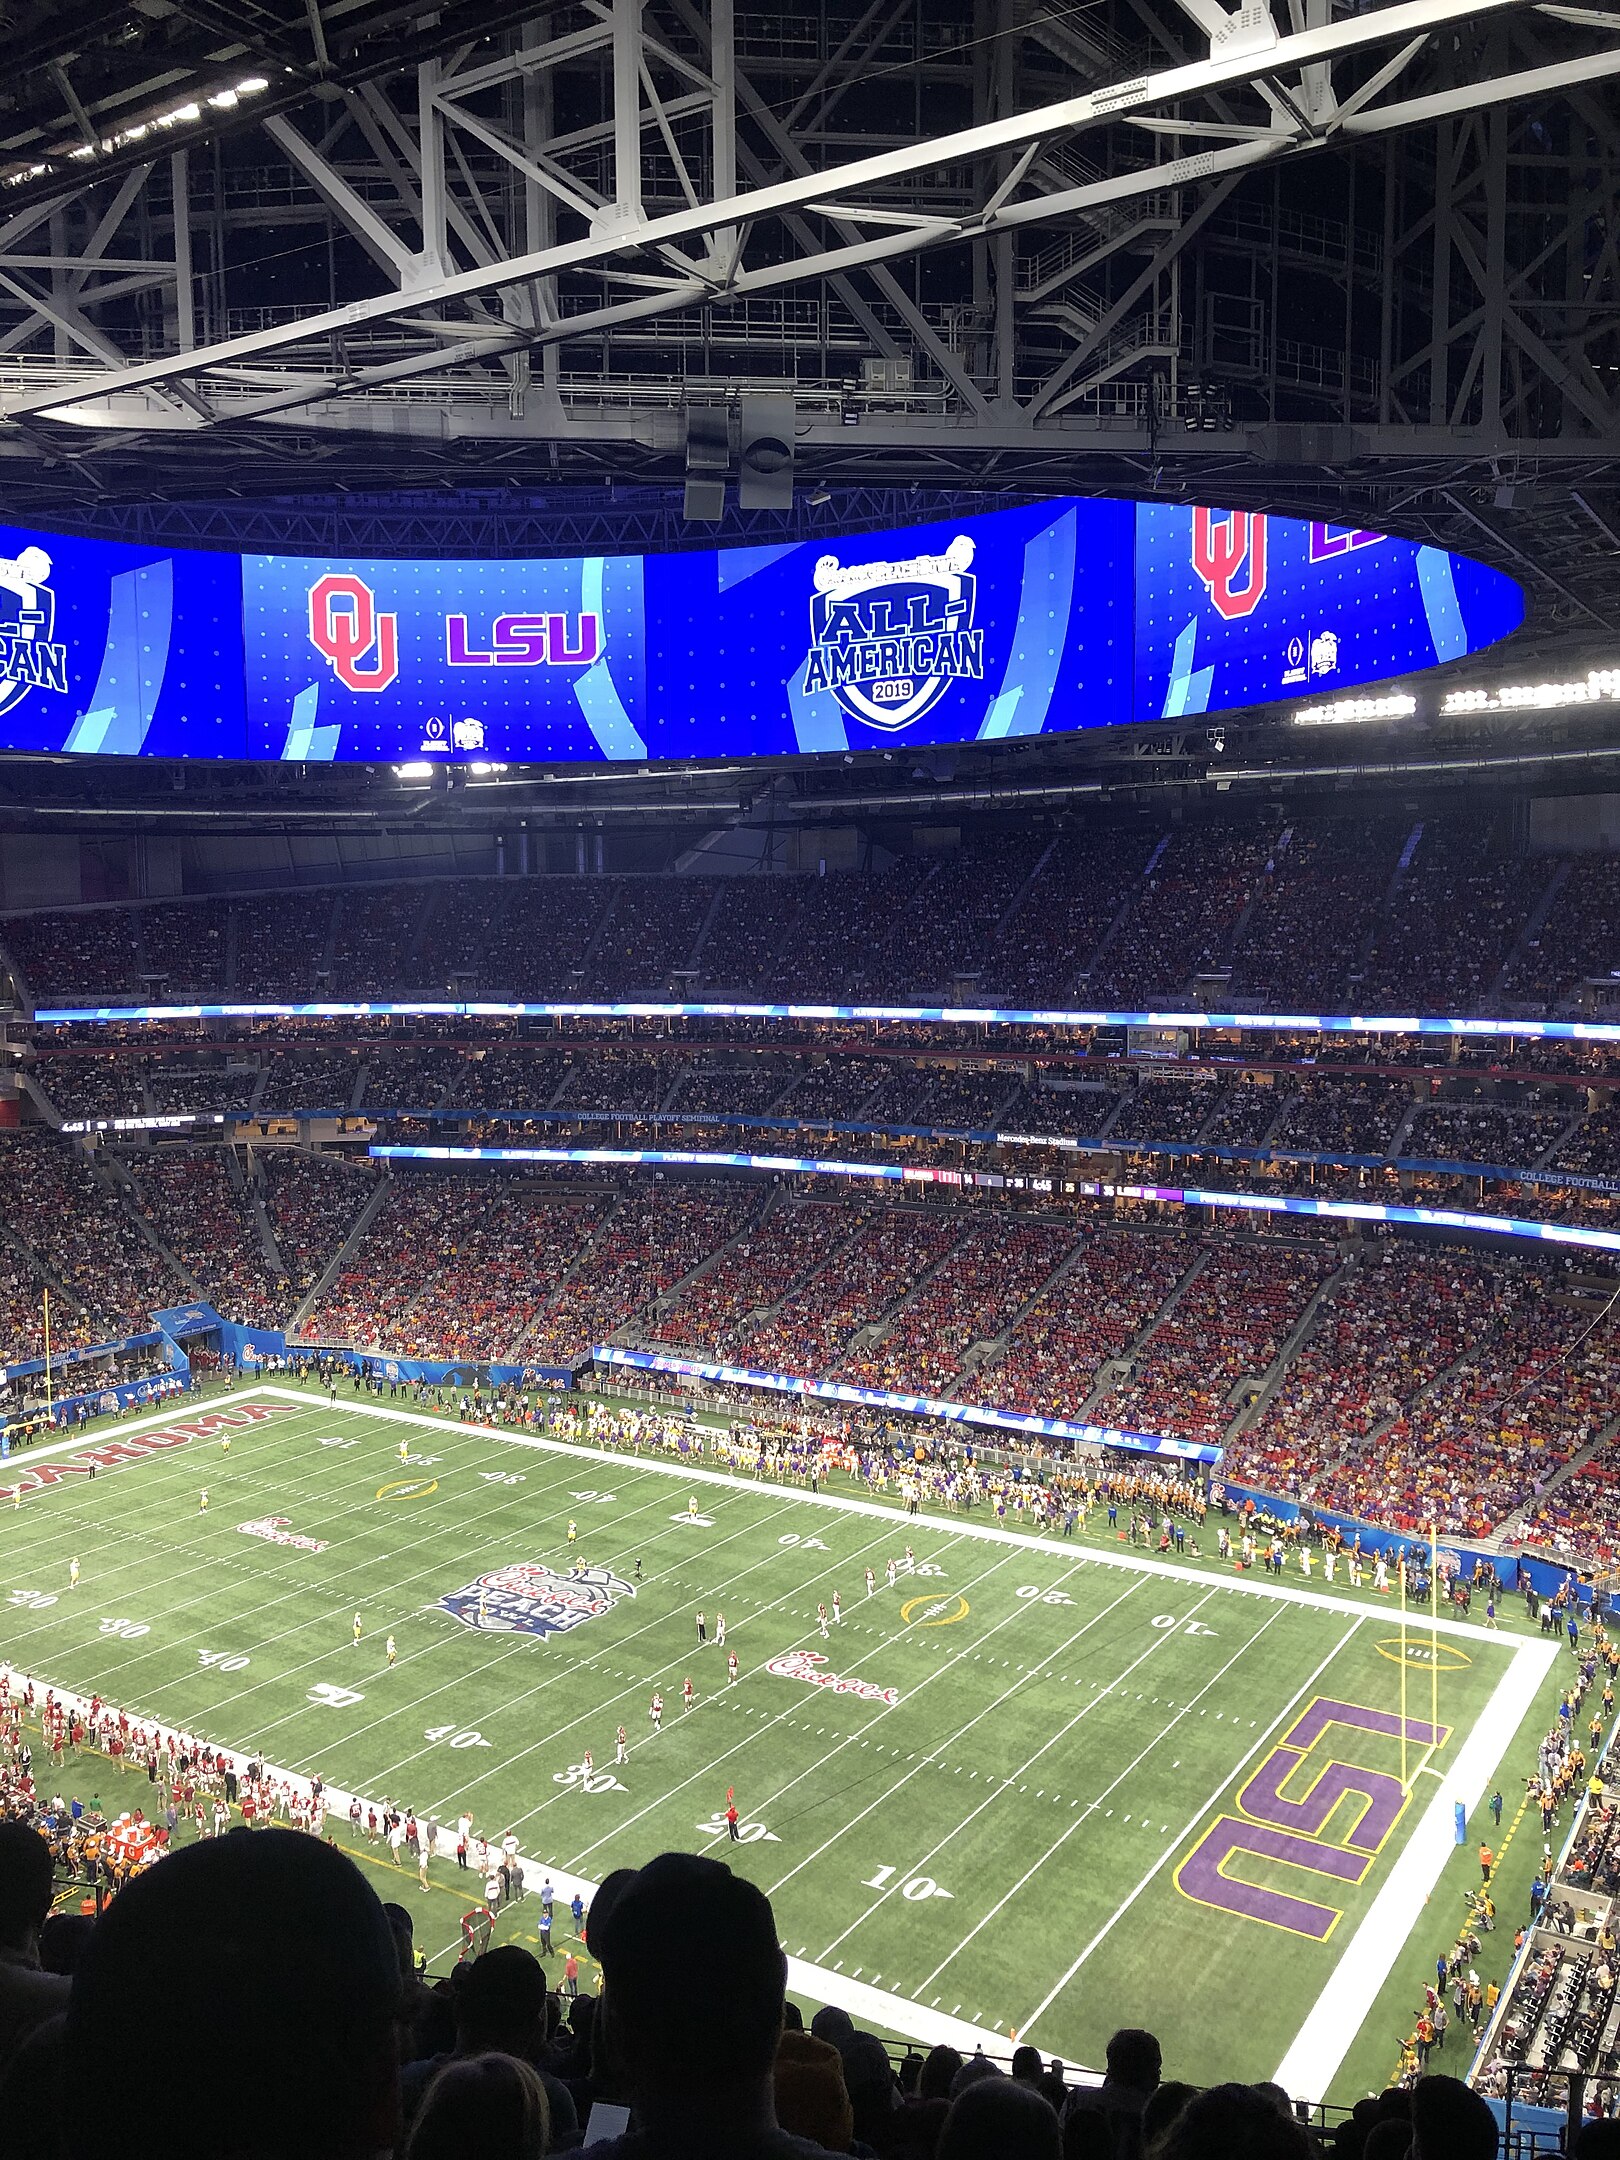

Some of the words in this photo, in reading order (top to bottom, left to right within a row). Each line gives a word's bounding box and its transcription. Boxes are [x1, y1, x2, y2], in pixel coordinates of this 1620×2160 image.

[1309, 521, 1388, 564] L
[308, 573, 398, 692] OU
[820, 595, 967, 645] ALL-
[446, 612, 600, 667] LSU
[803, 629, 984, 697] AMERICAN
[875, 682, 911, 698] 2019
[611, 1113, 647, 1121] FOOTBALL
[648, 1114, 681, 1122] PLAYOFF
[997, 1133, 1047, 1145] Mercedes-Benz
[1047, 1137, 1077, 1147] Stadium
[1520, 1171, 1563, 1184] COLLEGE
[1565, 1177, 1618, 1190] FOOTBALL
[485, 1471, 527, 1485] 30
[6, 1589, 59, 1609] 20
[446, 1584, 586, 1628] PEACH
[1015, 1585, 1071, 1604] 20
[99, 1618, 151, 1639] 30
[1151, 1614, 1208, 1635] 10
[198, 1649, 250, 1672] 40
[766, 1650, 898, 1705] Chick-fil-A
[424, 1724, 482, 1749] 40
[553, 1764, 617, 1793] 30
[1173, 1696, 1454, 1943] LSU
[860, 1864, 937, 1901] 10
